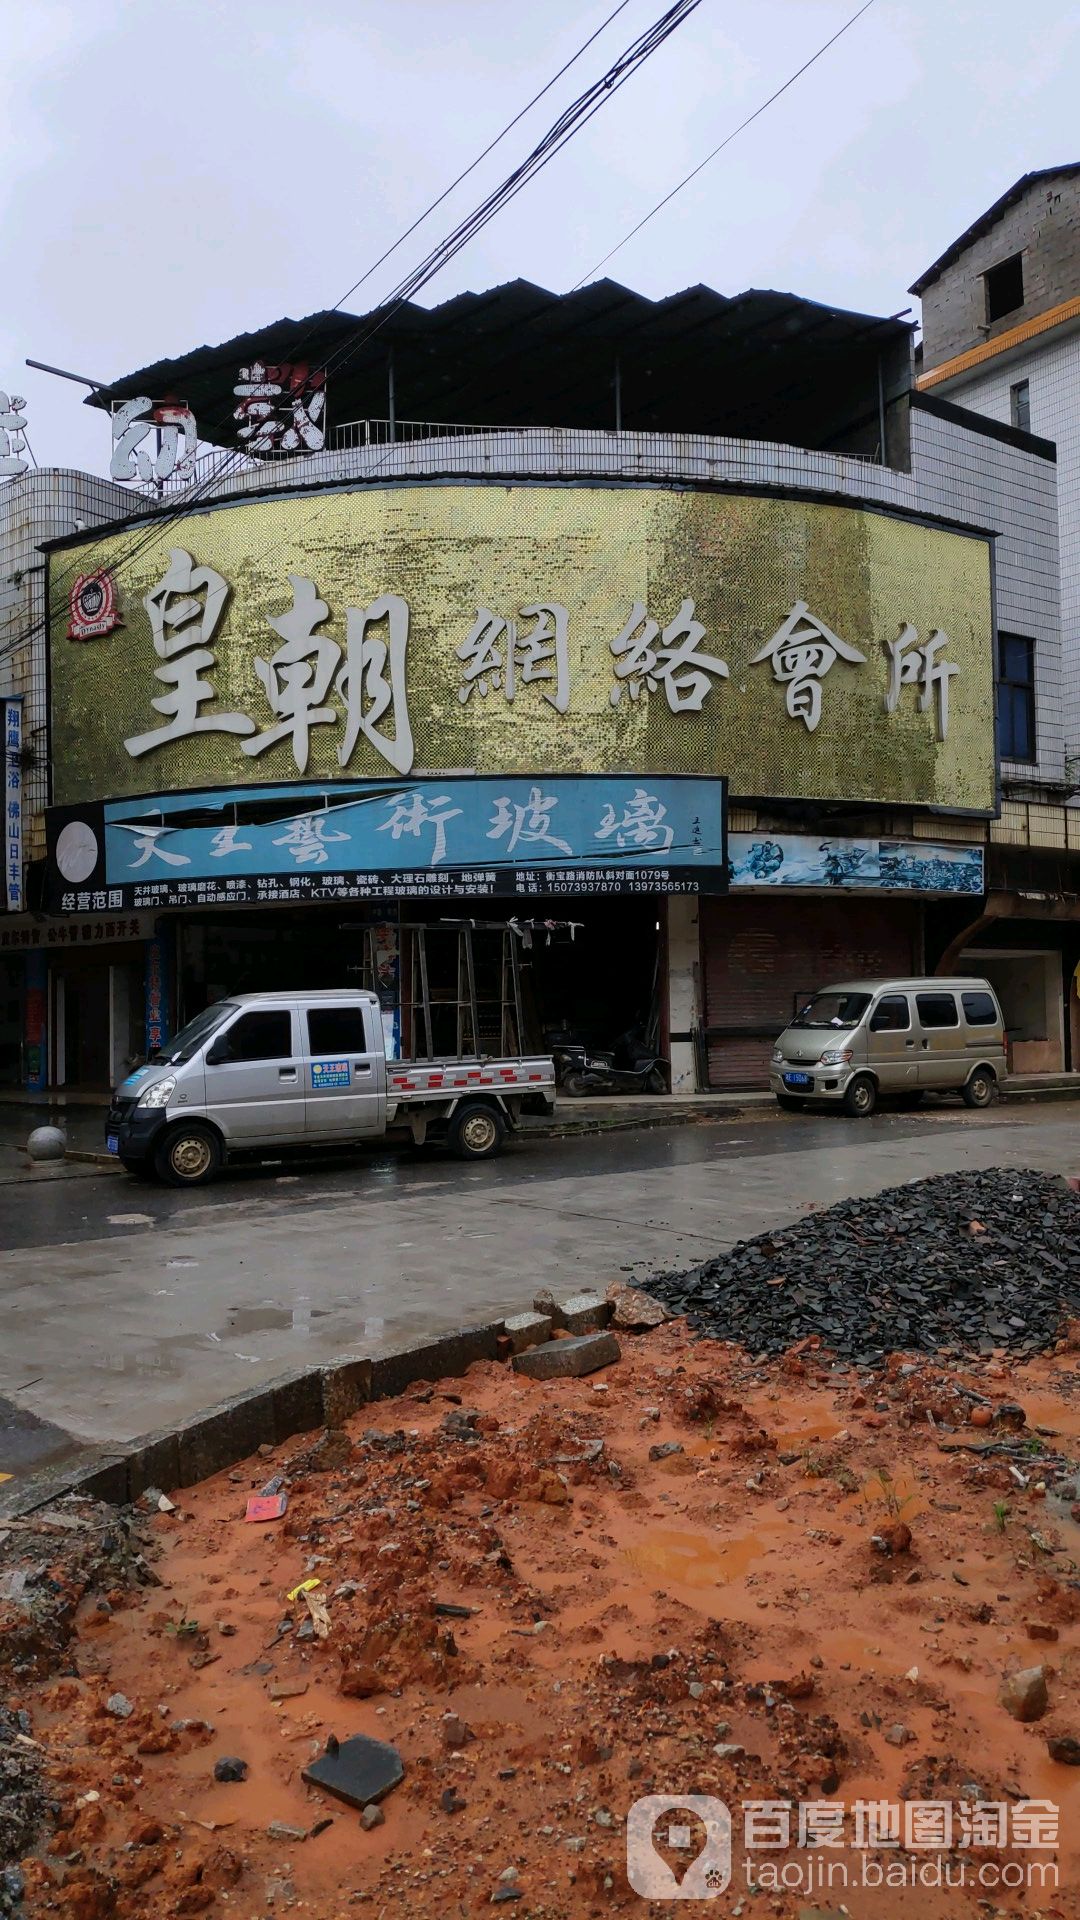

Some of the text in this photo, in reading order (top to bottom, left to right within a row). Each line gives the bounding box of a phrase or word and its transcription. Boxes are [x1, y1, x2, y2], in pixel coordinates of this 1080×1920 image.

[628, 881, 700, 893] 13973565173
[61, 890, 123, 912] 经营范围
